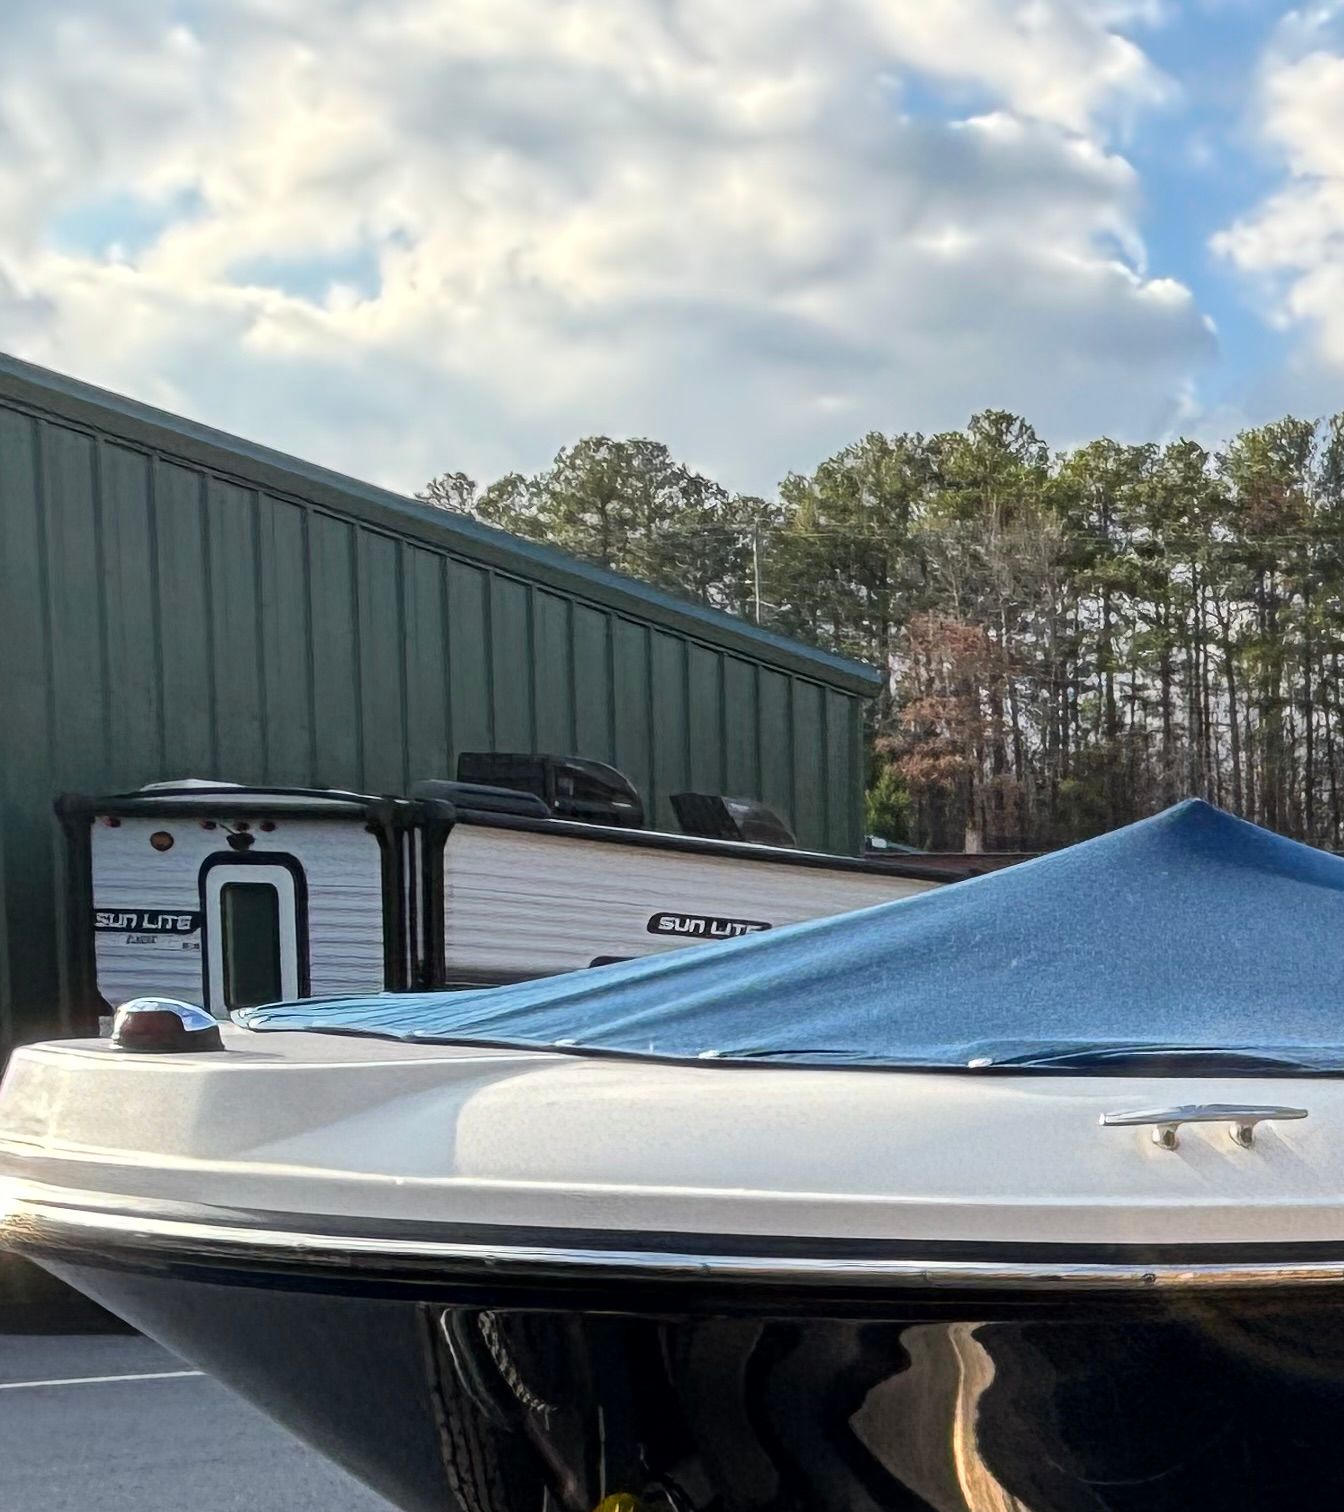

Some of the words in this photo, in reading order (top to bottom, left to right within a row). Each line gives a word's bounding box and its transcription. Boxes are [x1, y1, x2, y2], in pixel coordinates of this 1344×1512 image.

[95, 912, 138, 928] SUN
[142, 913, 193, 930] LITE
[658, 916, 706, 934] SUN
